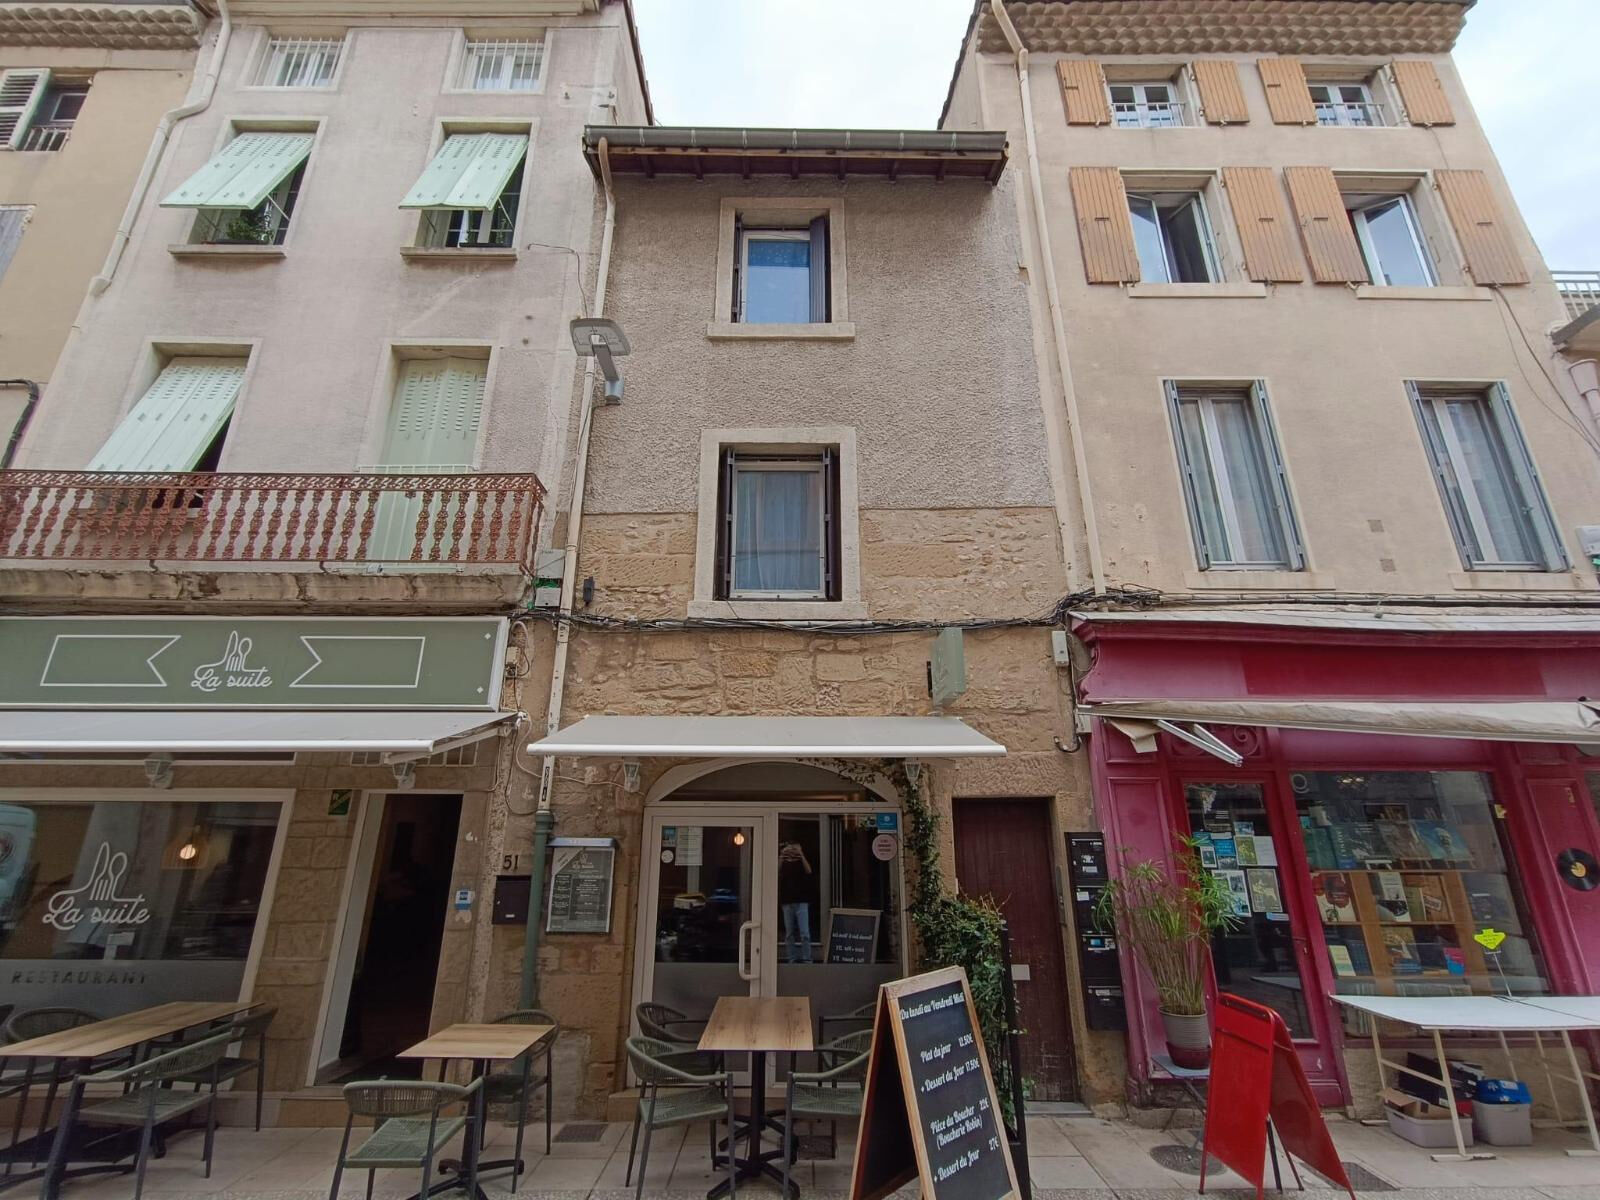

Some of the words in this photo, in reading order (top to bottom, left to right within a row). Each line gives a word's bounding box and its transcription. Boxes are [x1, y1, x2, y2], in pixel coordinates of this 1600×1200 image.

[190, 667, 222, 692] La
[226, 666, 273, 687] suite
[503, 854, 519, 871] 51
[42, 894, 84, 931] La
[91, 894, 150, 924] suite
[920, 1050, 933, 1063] Plat
[933, 1046, 941, 1058] du
[925, 1073, 946, 1091] Dessert
[945, 1070, 953, 1082] du
[946, 1115, 955, 1127] du
[953, 1105, 975, 1123] Boucher
[938, 1159, 960, 1181] Dessert
[959, 1155, 968, 1169] du
